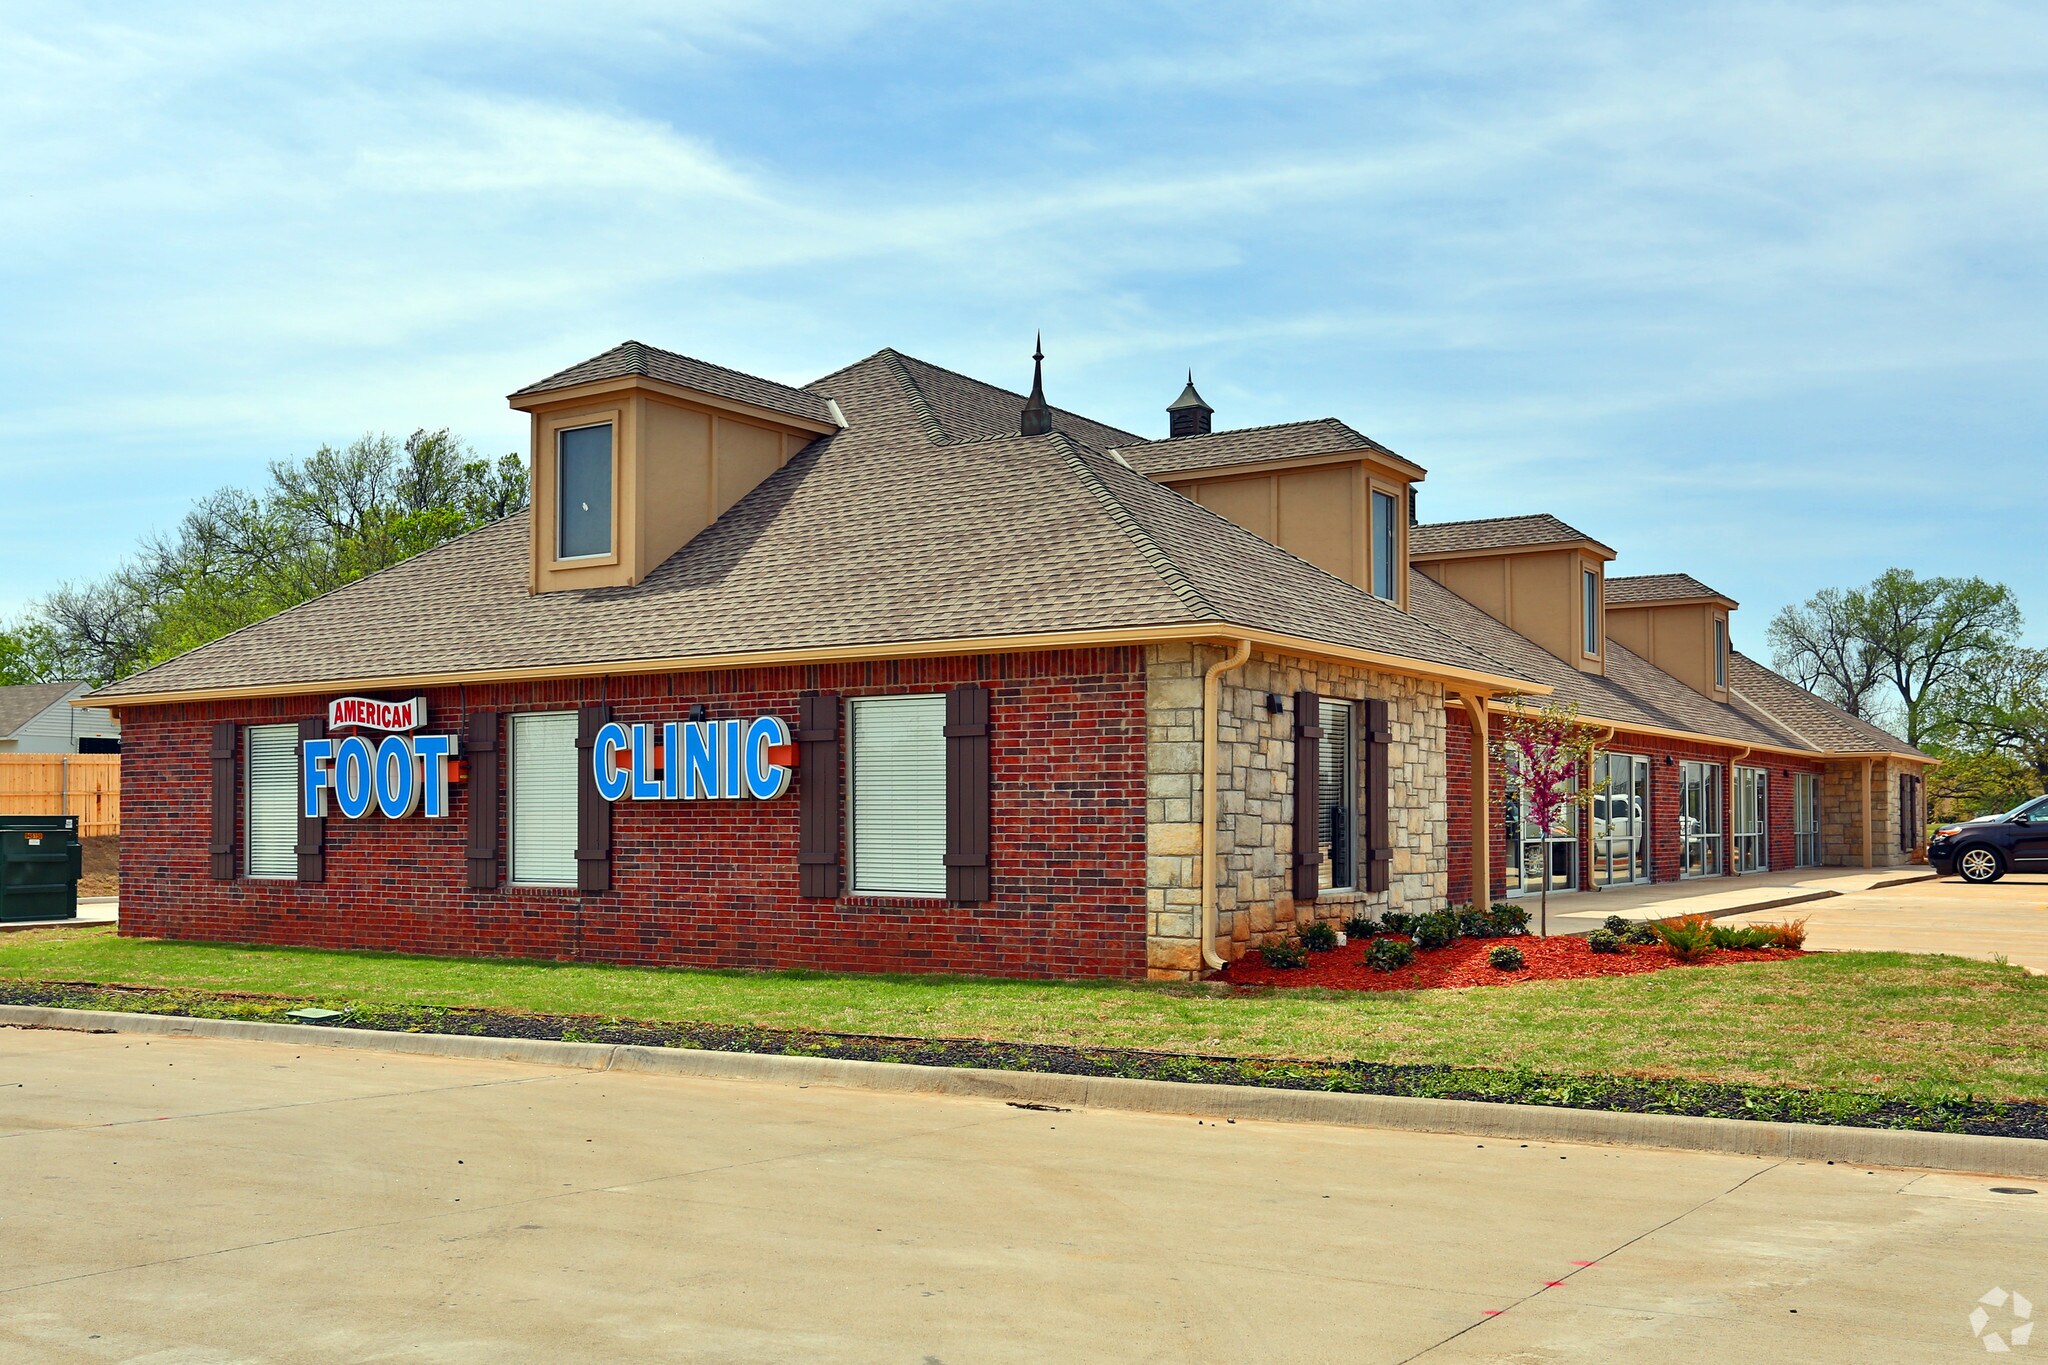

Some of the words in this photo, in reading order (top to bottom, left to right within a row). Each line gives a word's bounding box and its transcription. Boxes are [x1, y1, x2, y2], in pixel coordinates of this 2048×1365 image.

[333, 700, 412, 729] AMERICAN
[303, 734, 451, 820] FOOT
[592, 715, 787, 802] CLINIC
